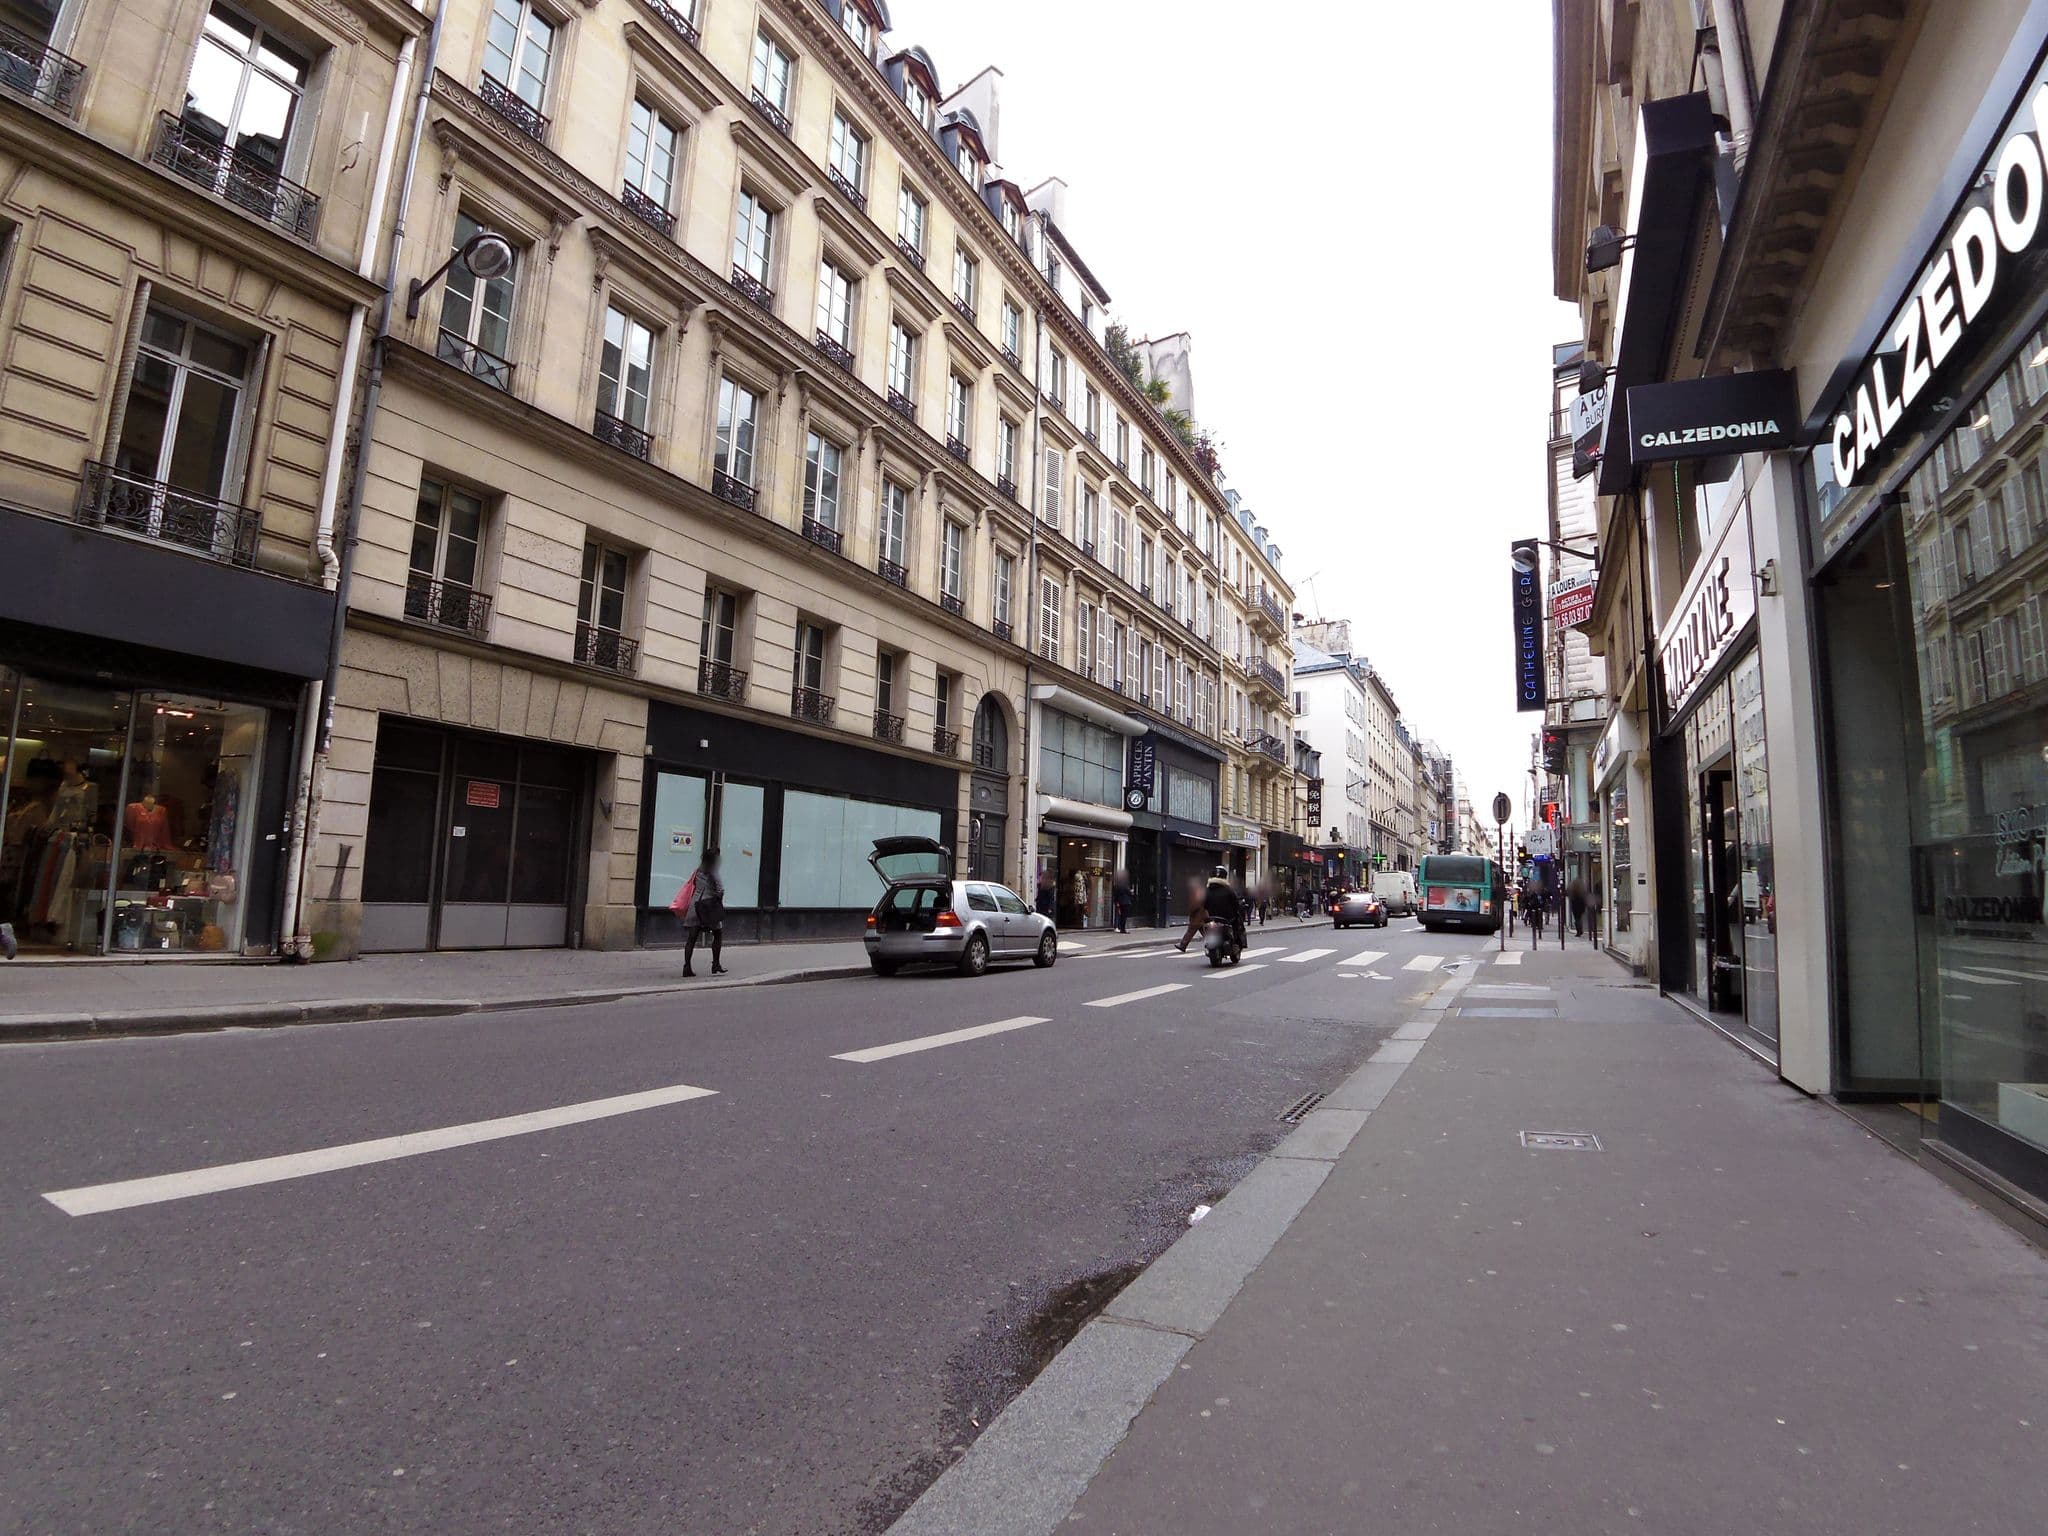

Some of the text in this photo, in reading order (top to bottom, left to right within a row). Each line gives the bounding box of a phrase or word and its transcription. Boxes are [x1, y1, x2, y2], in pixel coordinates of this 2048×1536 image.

[1591, 384, 1606, 406] LO
[1640, 420, 1780, 448] CALZEDONIA
[1556, 577, 1576, 594] LOUER
[1577, 606, 1584, 621] 97
[1522, 616, 1537, 700] CATHERINE
[1132, 740, 1143, 789] APRICES
